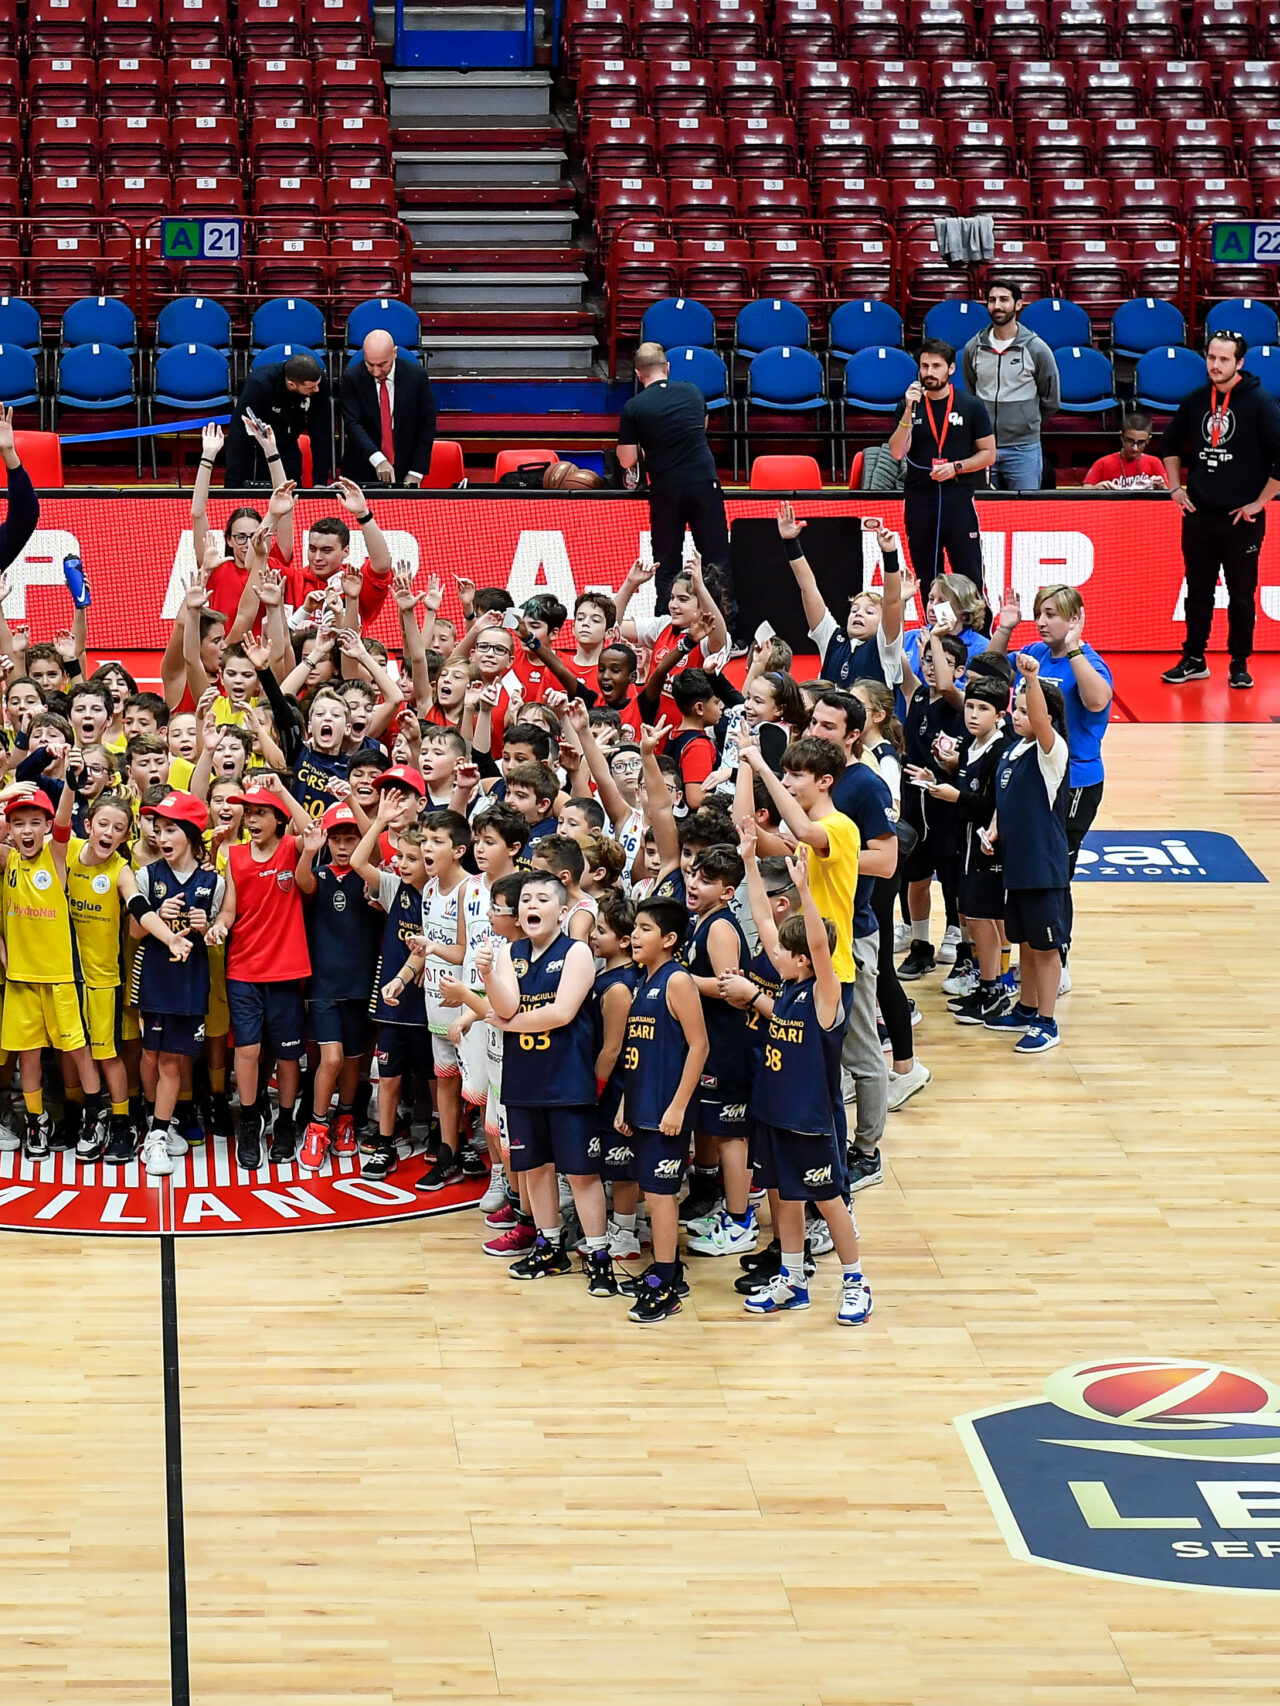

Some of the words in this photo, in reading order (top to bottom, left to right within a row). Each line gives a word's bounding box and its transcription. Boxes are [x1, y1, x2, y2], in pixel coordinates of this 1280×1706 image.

[170, 227, 194, 253] A
[207, 226, 239, 254] 21
[1221, 229, 1244, 254] A
[622, 834, 637, 852] 36
[14, 904, 57, 918] HydroNat
[519, 1031, 551, 1050] 63
[654, 1159, 681, 1174] SGM
[803, 1164, 832, 1183] SGM
